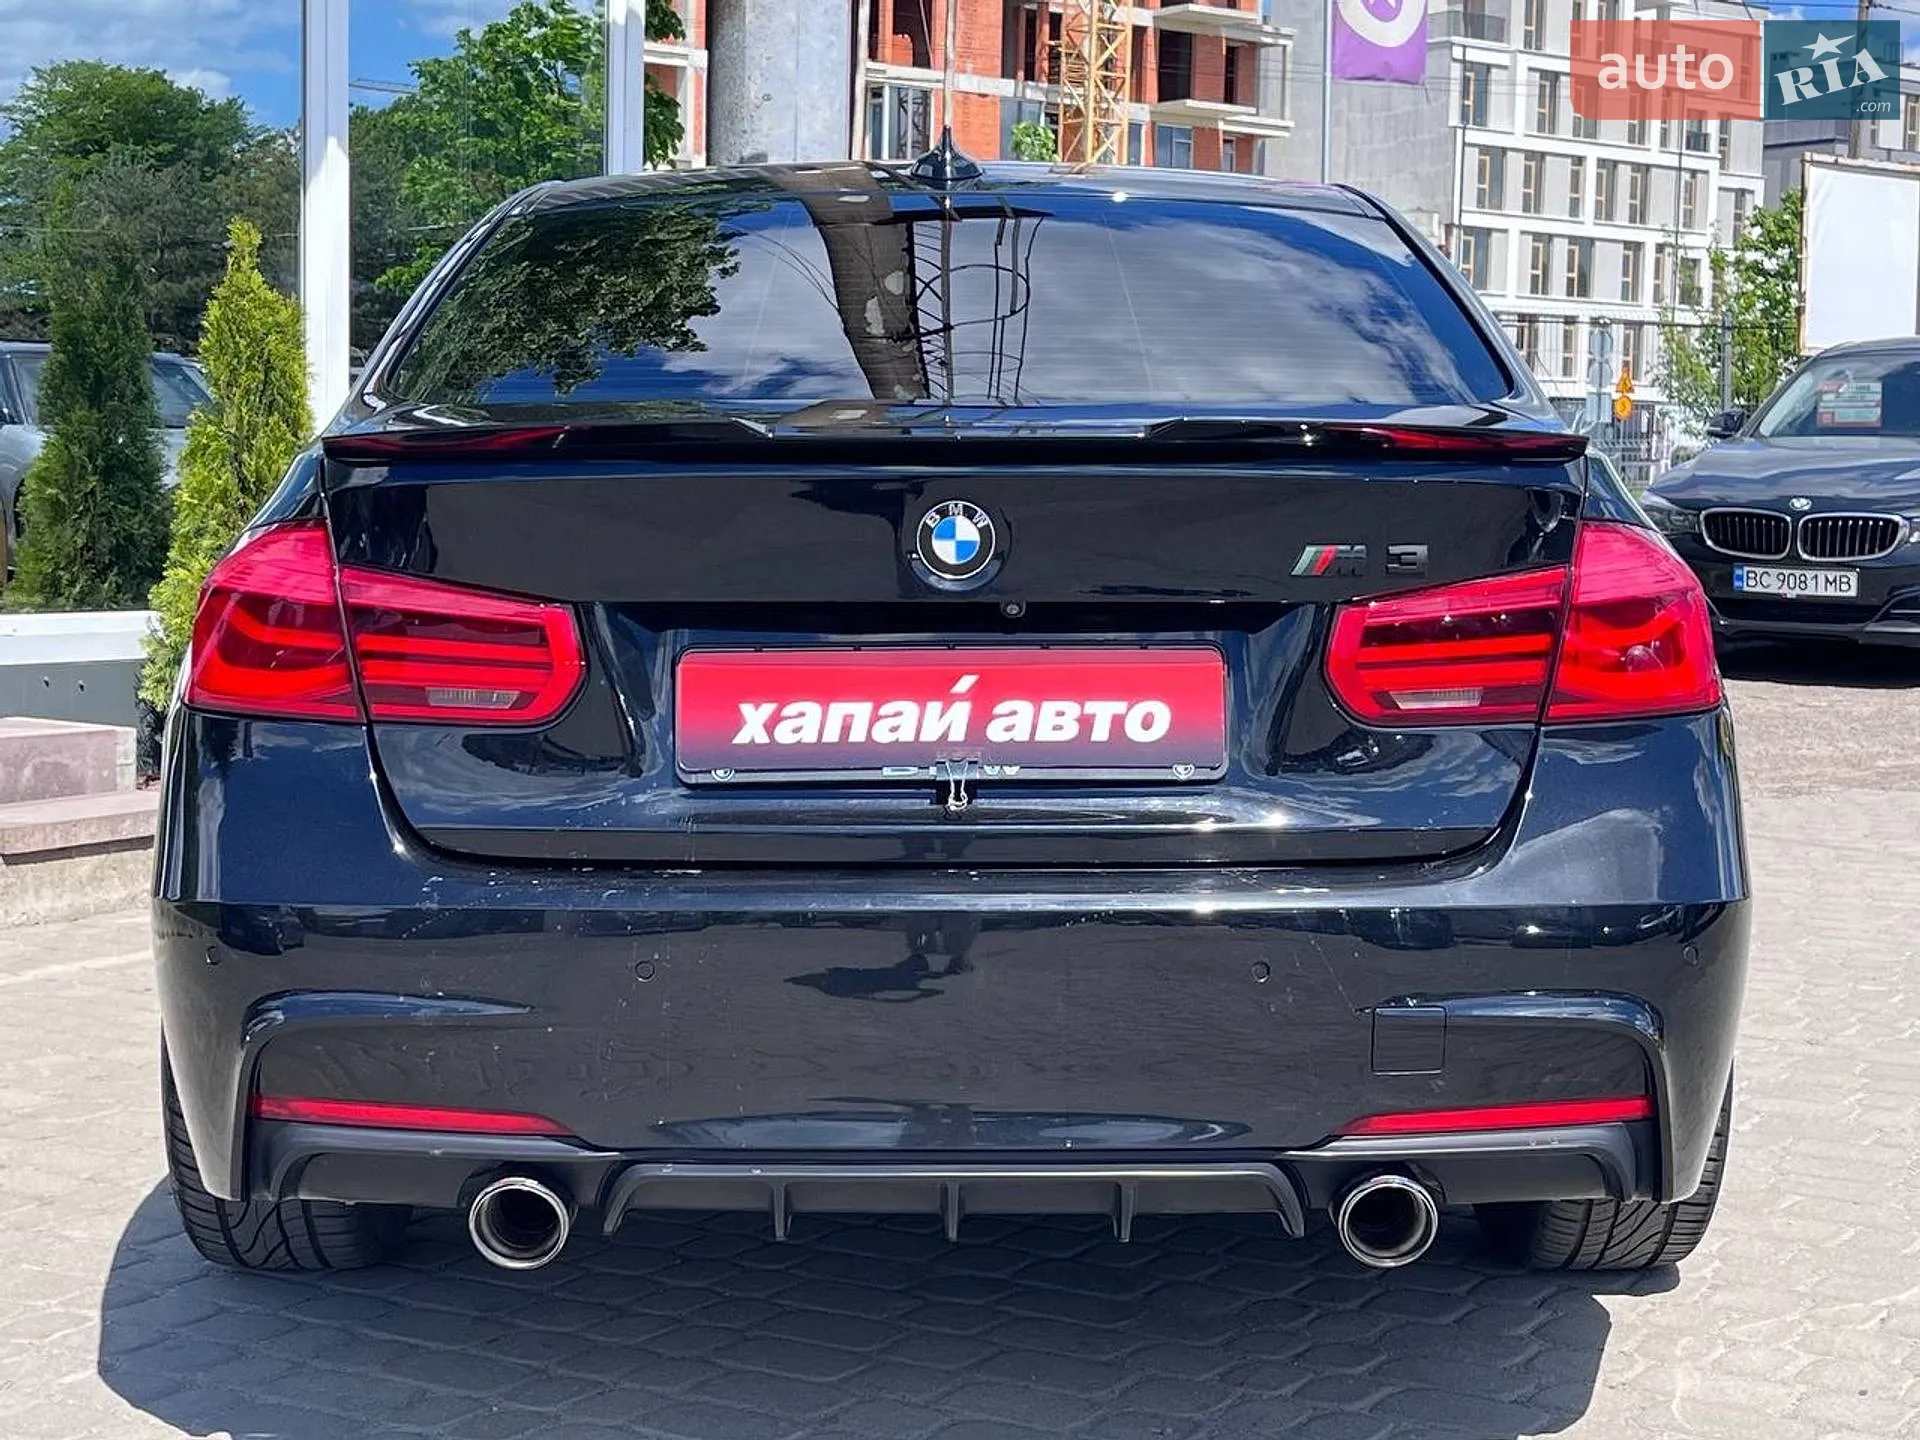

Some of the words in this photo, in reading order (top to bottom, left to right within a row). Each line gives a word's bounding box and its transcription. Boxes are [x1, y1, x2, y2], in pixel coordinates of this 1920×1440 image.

[925, 503, 988, 529] BMW
[1746, 570, 1771, 589] BC
[1776, 571, 1819, 593] 9081
[1824, 574, 1851, 592] MB
[985, 697, 1172, 743] авто
